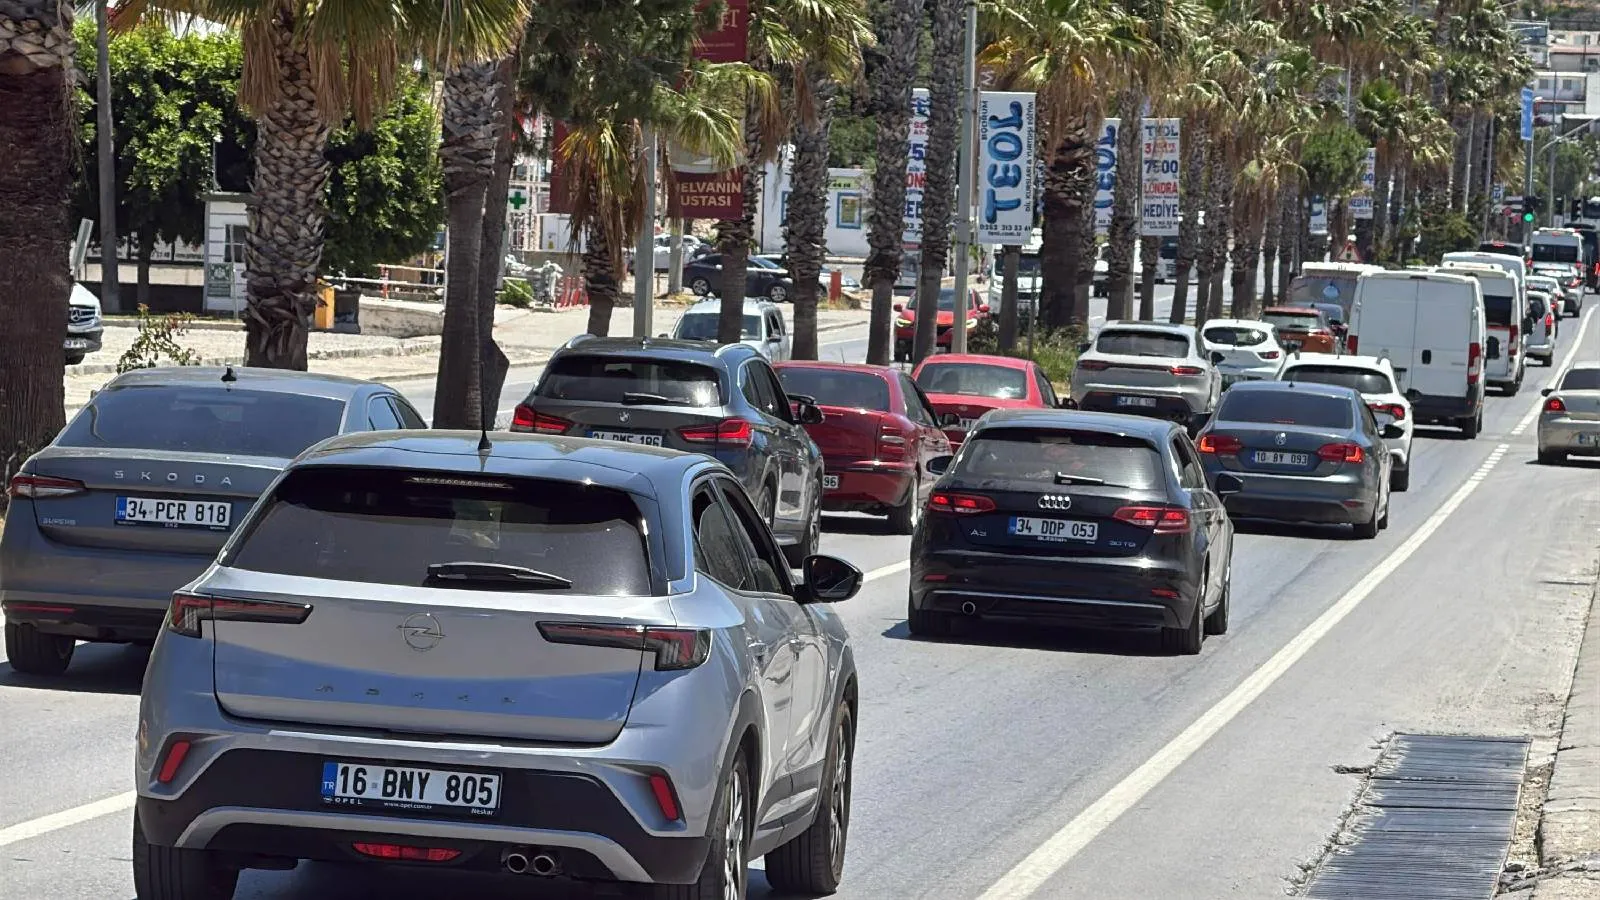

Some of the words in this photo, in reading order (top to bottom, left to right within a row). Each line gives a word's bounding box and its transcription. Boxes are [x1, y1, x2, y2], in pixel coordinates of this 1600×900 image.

[981, 100, 989, 141] BODRUM
[985, 101, 1024, 224] TEOL
[1144, 182, 1178, 194] LONDRA
[680, 195, 732, 207] USTASI
[1143, 200, 1178, 217] HEDİYE
[1291, 454, 1307, 464] 093
[114, 470, 232, 486] SKODA
[127, 500, 147, 518] 34
[155, 502, 187, 520] PCR
[195, 504, 227, 523] 818
[1017, 518, 1032, 533] 34
[1071, 523, 1095, 538] 053
[323, 781, 334, 789] TR
[340, 766, 368, 796] 16
[382, 769, 430, 800] BNY
[445, 774, 494, 805] 805
